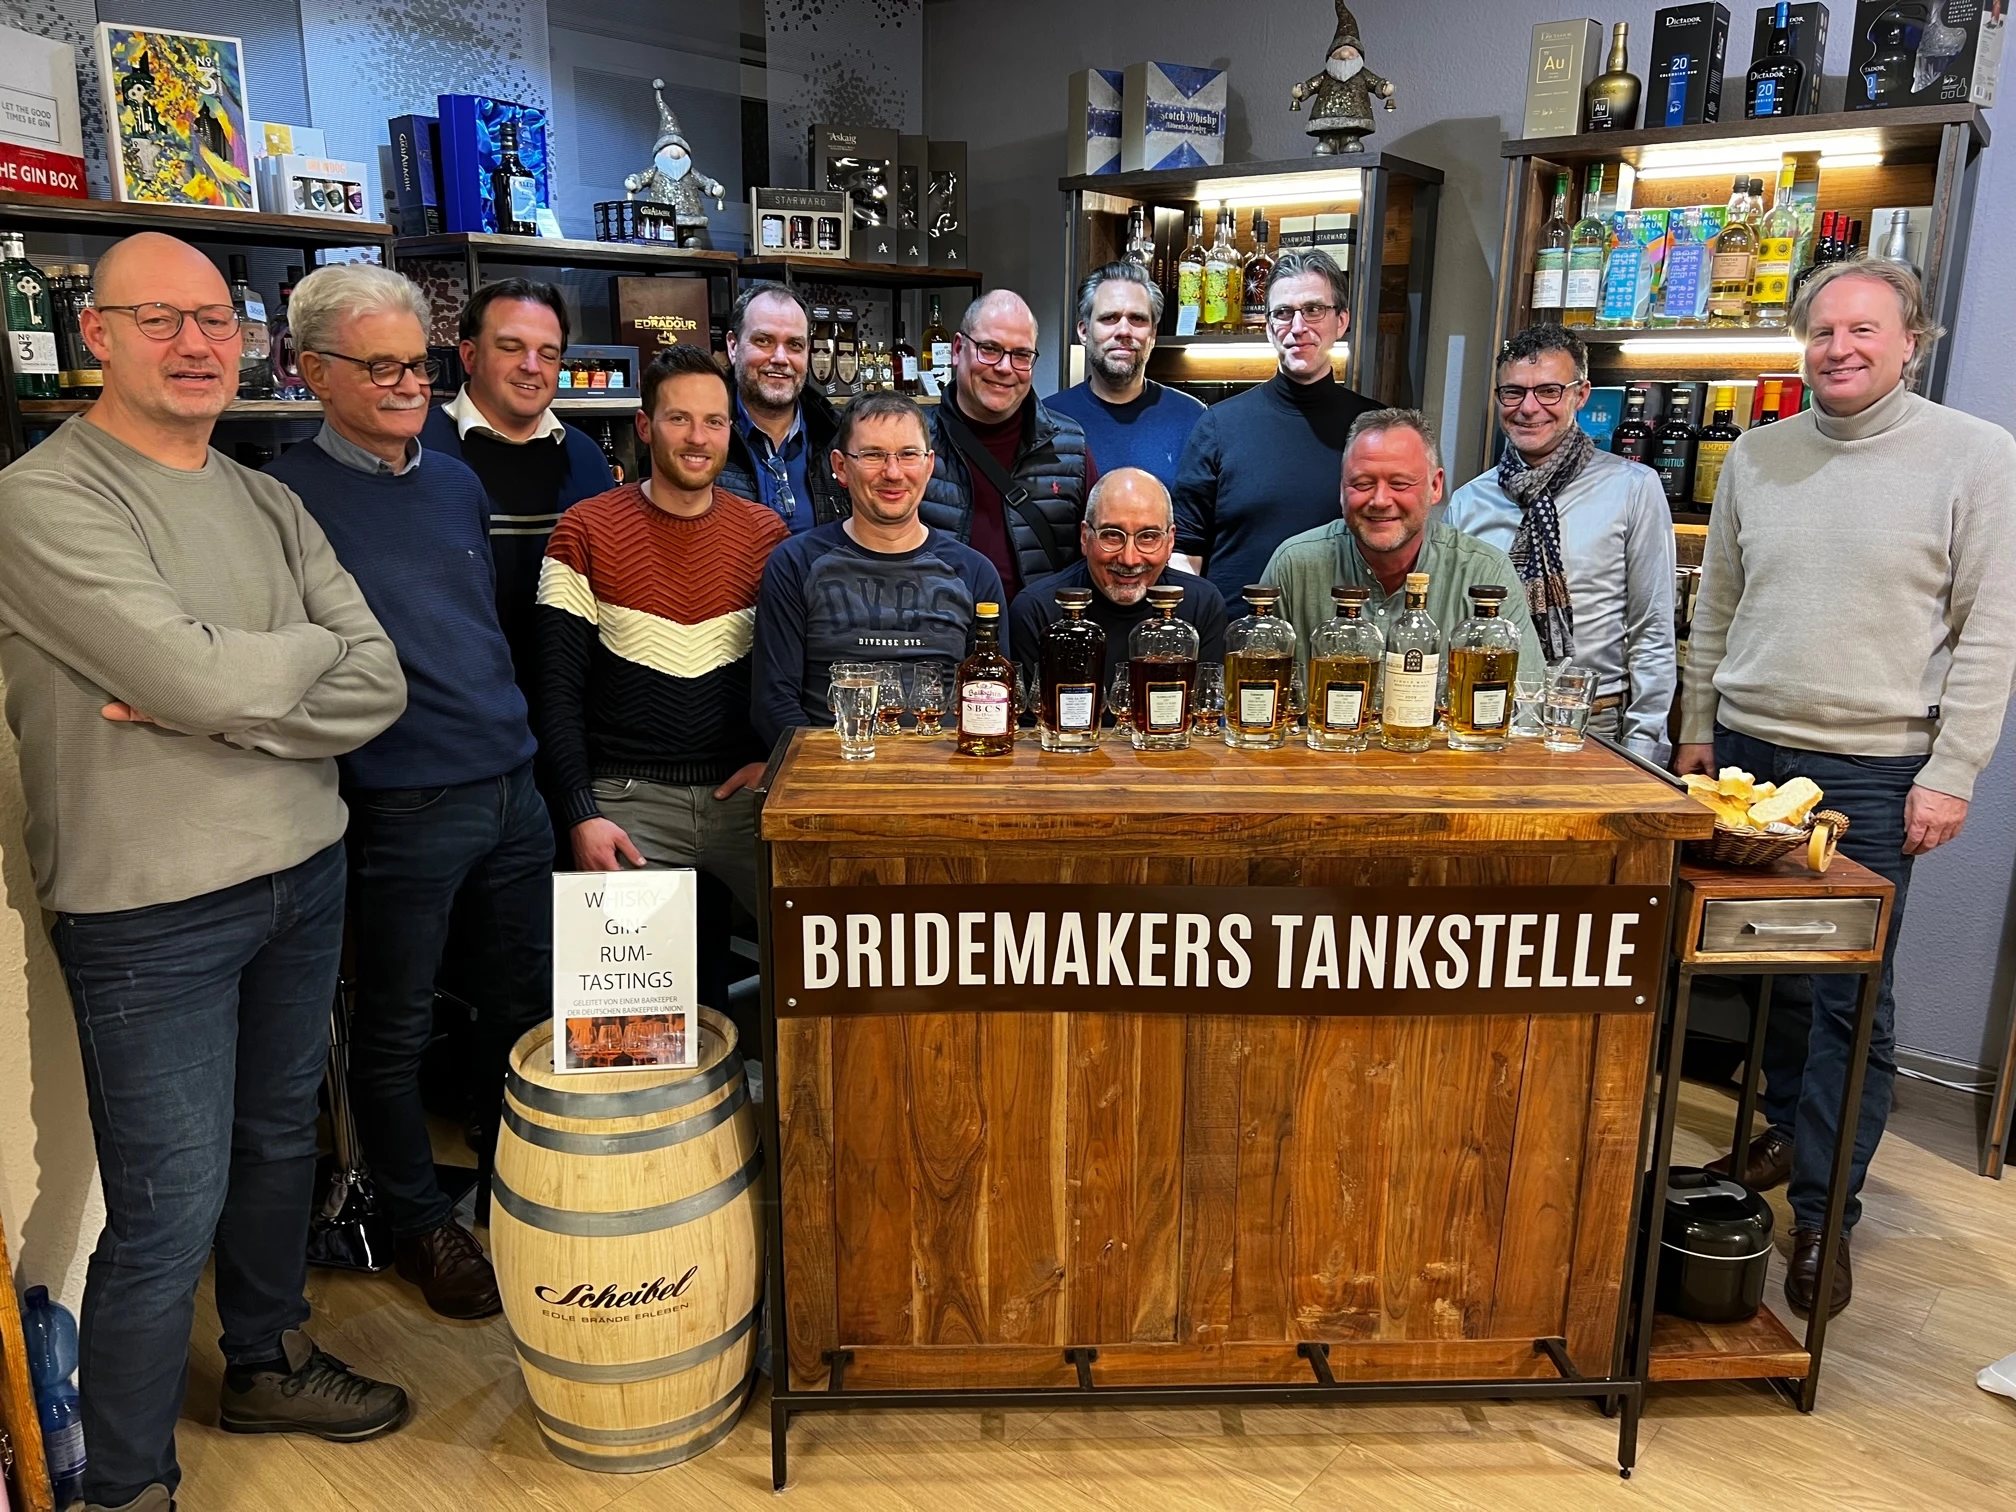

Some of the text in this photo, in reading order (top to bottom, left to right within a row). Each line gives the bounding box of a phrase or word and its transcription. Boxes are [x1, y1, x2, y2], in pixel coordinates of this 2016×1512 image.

[1544, 55, 1565, 71] Au
[1672, 57, 1688, 70] 20
[1758, 83, 1773, 97] 20
[1, 102, 51, 119] LET THE GOOD
[1595, 103, 1606, 112] Au
[6, 111, 51, 128] TIMES BE GIN
[1187, 111, 1217, 128] Whisky
[0, 162, 79, 191] HE GIN BOX
[775, 195, 826, 206] STARWARD
[1316, 232, 1347, 241] STARWARD
[634, 319, 697, 330] EDRADOUR
[19, 341, 34, 361] 3
[1591, 411, 1607, 422] 18
[1654, 458, 1685, 467] MAURITIUS
[858, 638, 899, 646] DIVERSE
[600, 945, 652, 963] RUM-
[802, 912, 1640, 990] BRIDEMAKERS TANKSTELLE
[579, 971, 673, 991] TASTINGS
[573, 999, 602, 1007] GELEITET
[641, 996, 678, 1004] BARKEEPER
[581, 1008, 621, 1016] DEUTSCHEN
[659, 1005, 684, 1013] UNION!
[535, 1265, 698, 1308] Scheibel
[542, 1309, 576, 1322] EDLE
[635, 1302, 690, 1320] ERLEBEN
